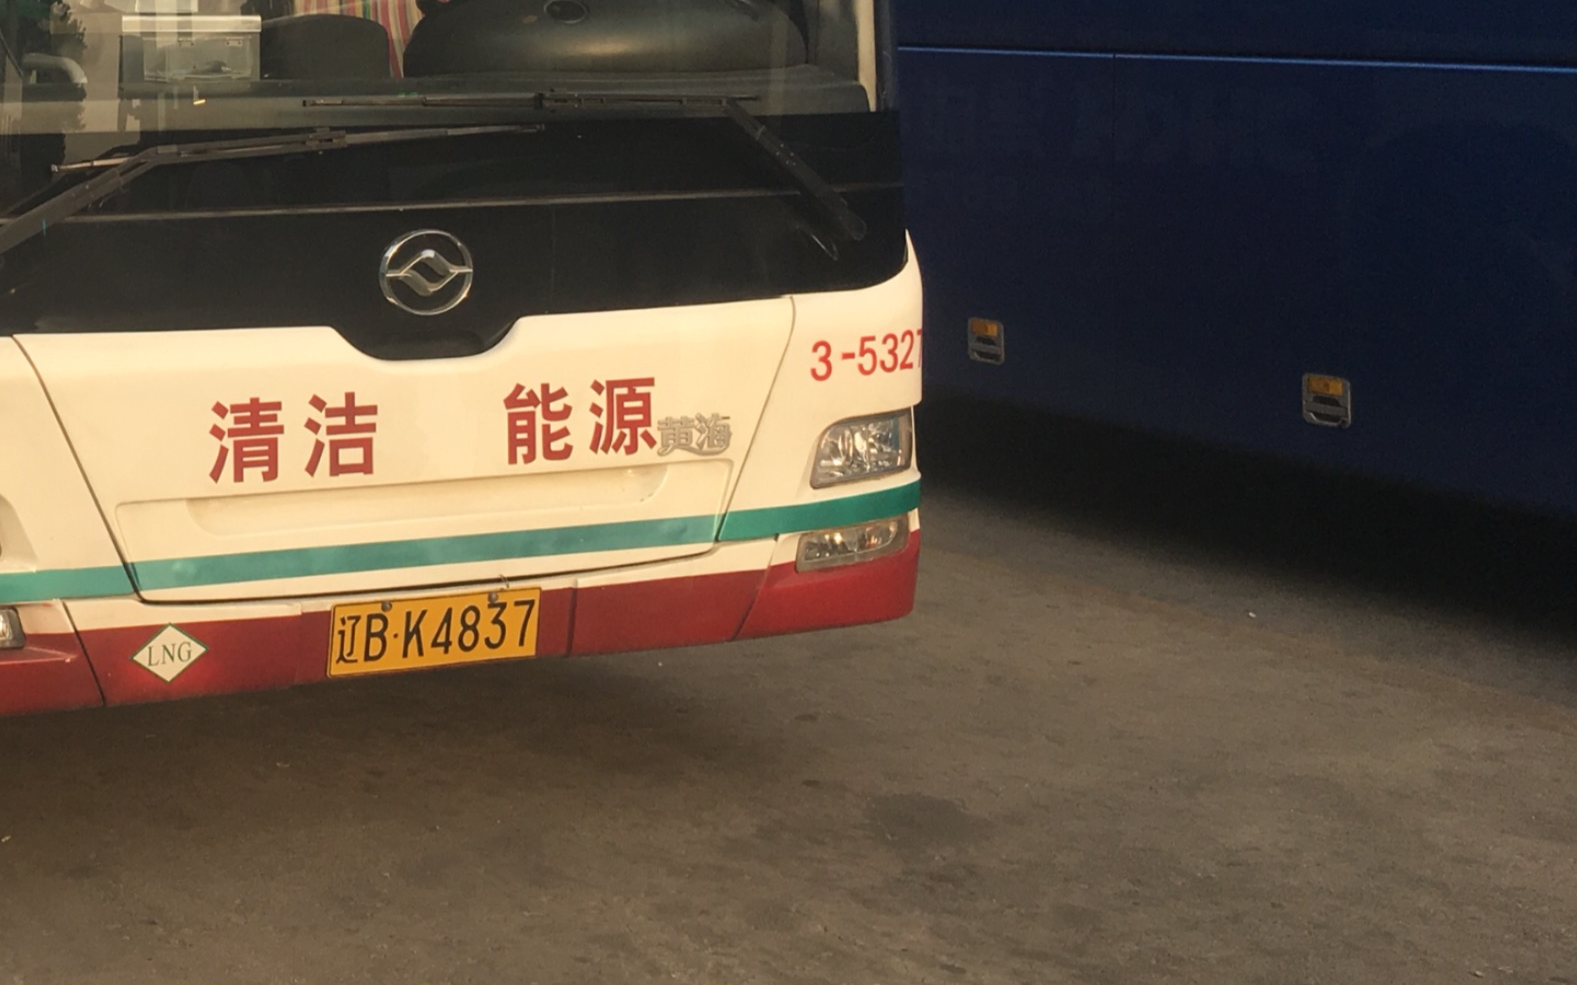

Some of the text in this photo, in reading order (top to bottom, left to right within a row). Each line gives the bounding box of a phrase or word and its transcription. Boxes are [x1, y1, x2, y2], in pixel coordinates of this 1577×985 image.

[208, 376, 658, 484] 清洁 能源
[657, 411, 733, 457] 黄海
[145, 640, 194, 668] LNG
[335, 598, 537, 665] 辽B·K4837
